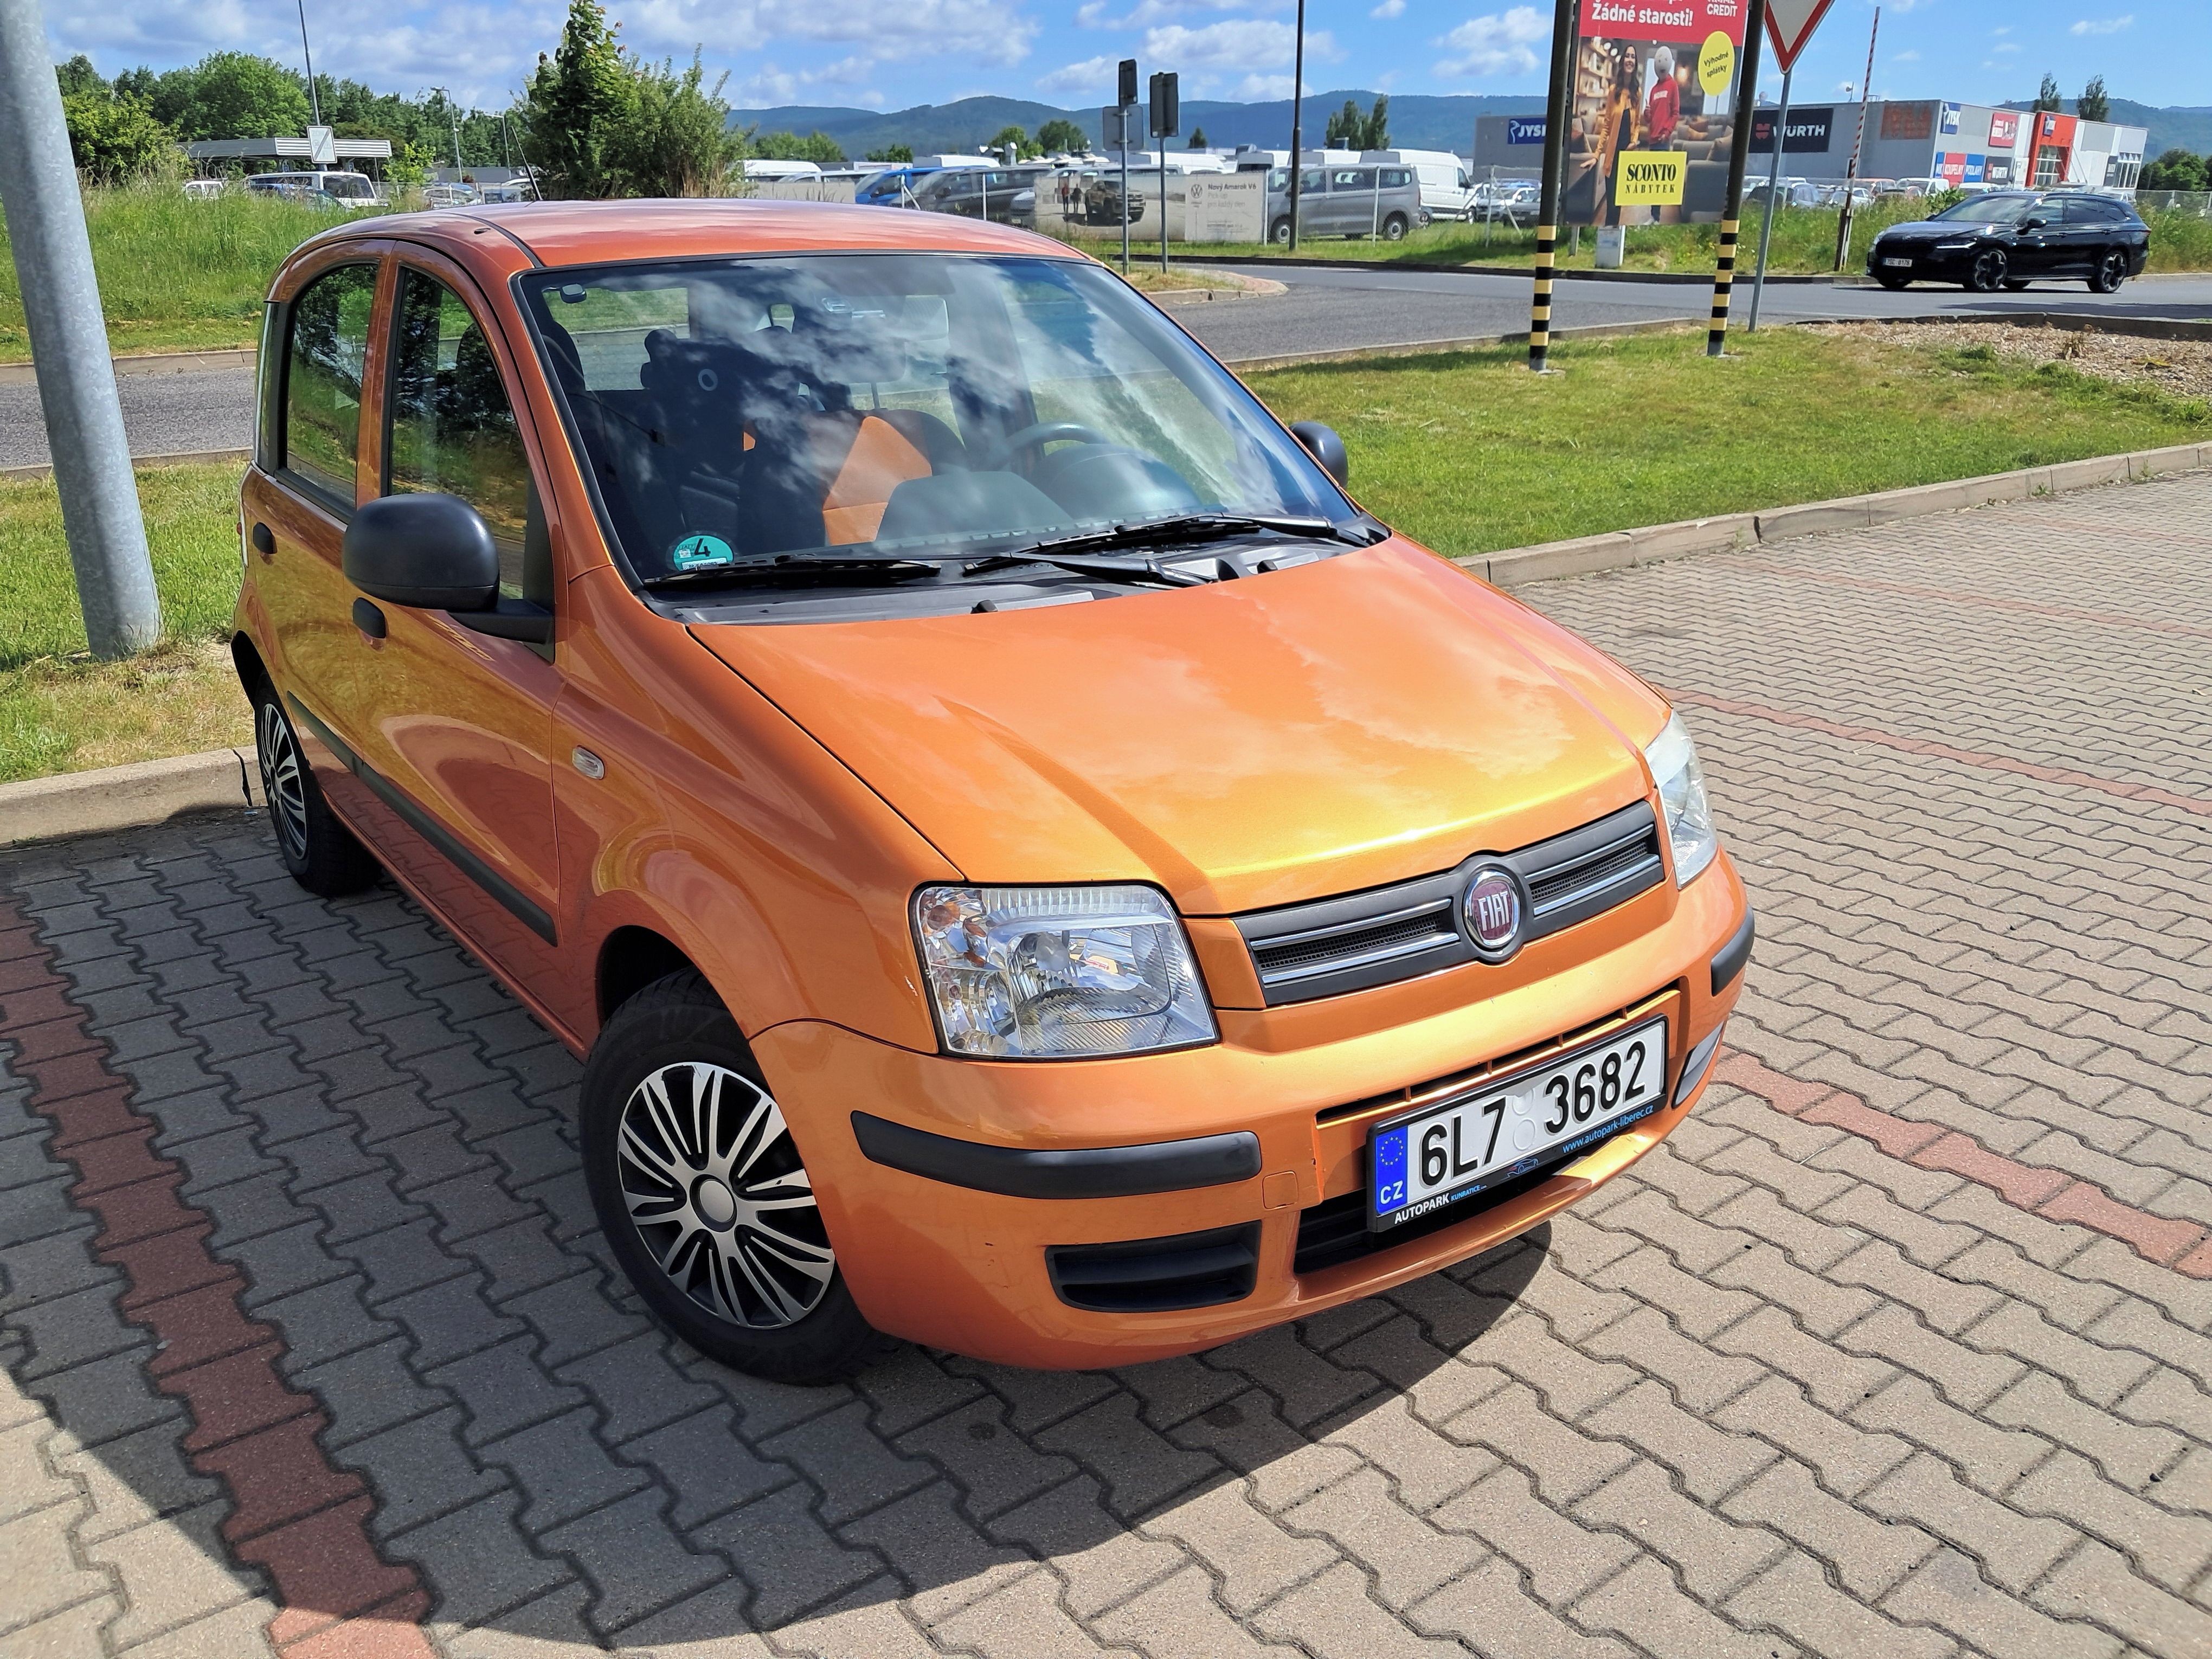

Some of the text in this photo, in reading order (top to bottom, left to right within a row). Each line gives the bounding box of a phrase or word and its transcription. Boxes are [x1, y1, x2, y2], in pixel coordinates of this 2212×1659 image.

[1591, 0, 1694, 27] Žádné starosti!
[1707, 3, 1738, 17] CREDIT
[1703, 52, 1729, 68] Výhodné
[1626, 164, 1676, 182] SCONTO
[1207, 183, 1223, 192] Nový
[1625, 182, 1675, 194] NÁBYTEK
[695, 537, 711, 557] 4
[1477, 889, 1510, 932] FIAT
[1420, 1040, 1646, 1186] 6L7 3682
[1562, 1104, 1654, 1154] www.autopark-liberec.cz
[1380, 1180, 1403, 1205] CZ
[1394, 1184, 1481, 1225] AUTOPARK KUNRATICE
